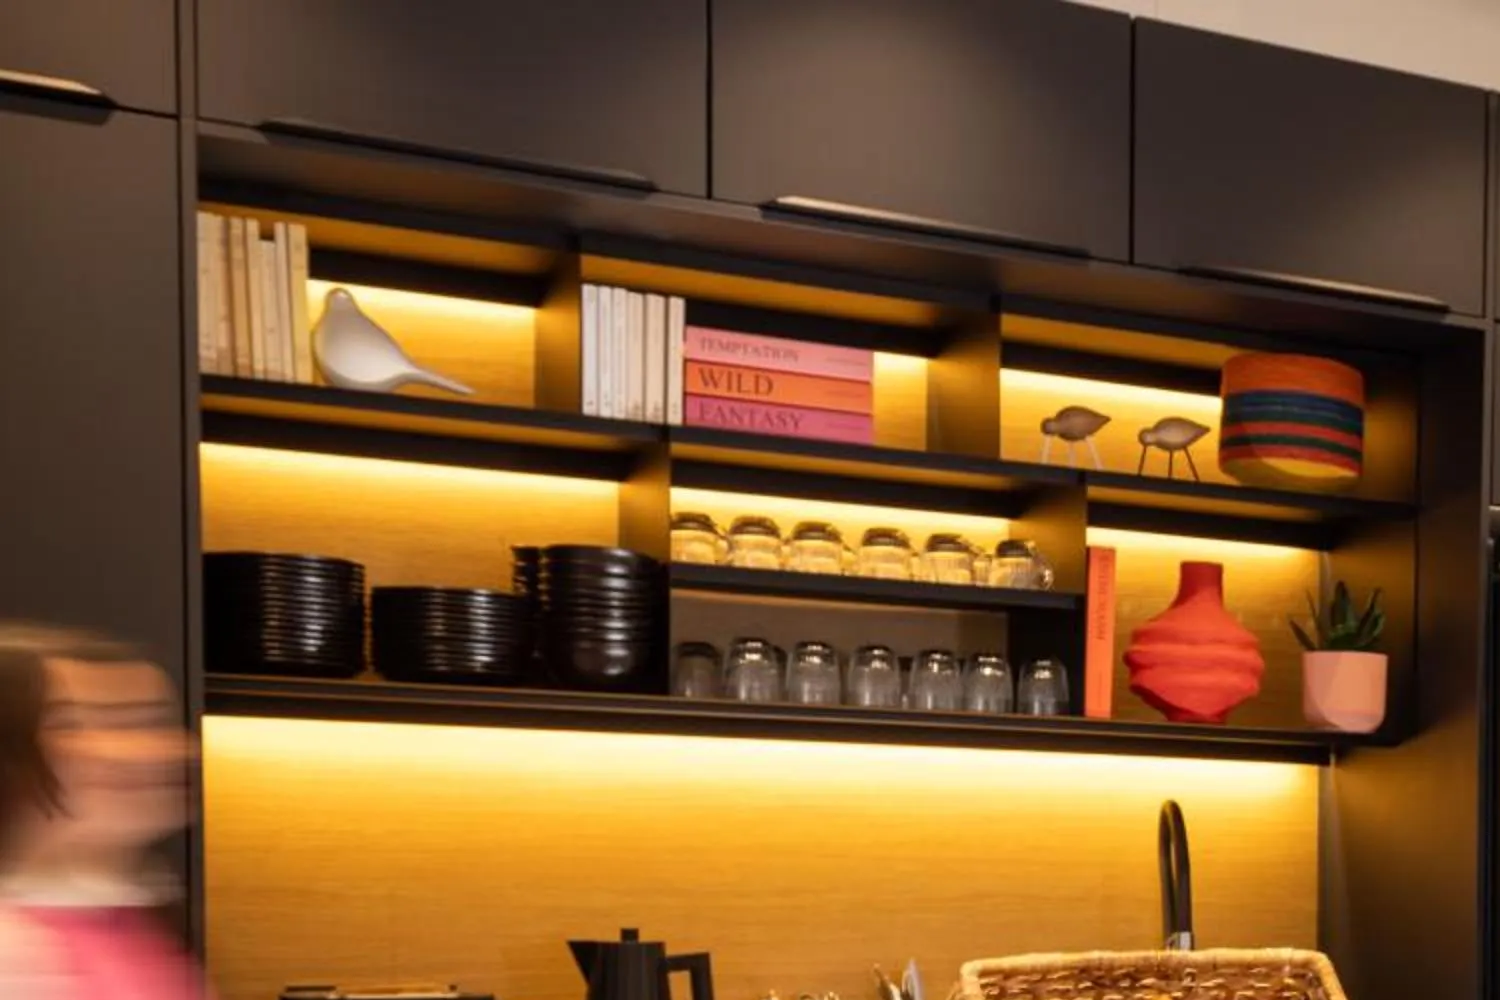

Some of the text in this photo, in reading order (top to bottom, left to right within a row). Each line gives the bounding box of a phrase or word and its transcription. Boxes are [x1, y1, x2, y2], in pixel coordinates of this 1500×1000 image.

[699, 336, 801, 363] TEMPTATION
[697, 367, 774, 397] WILD
[697, 399, 804, 433] FANTASY
